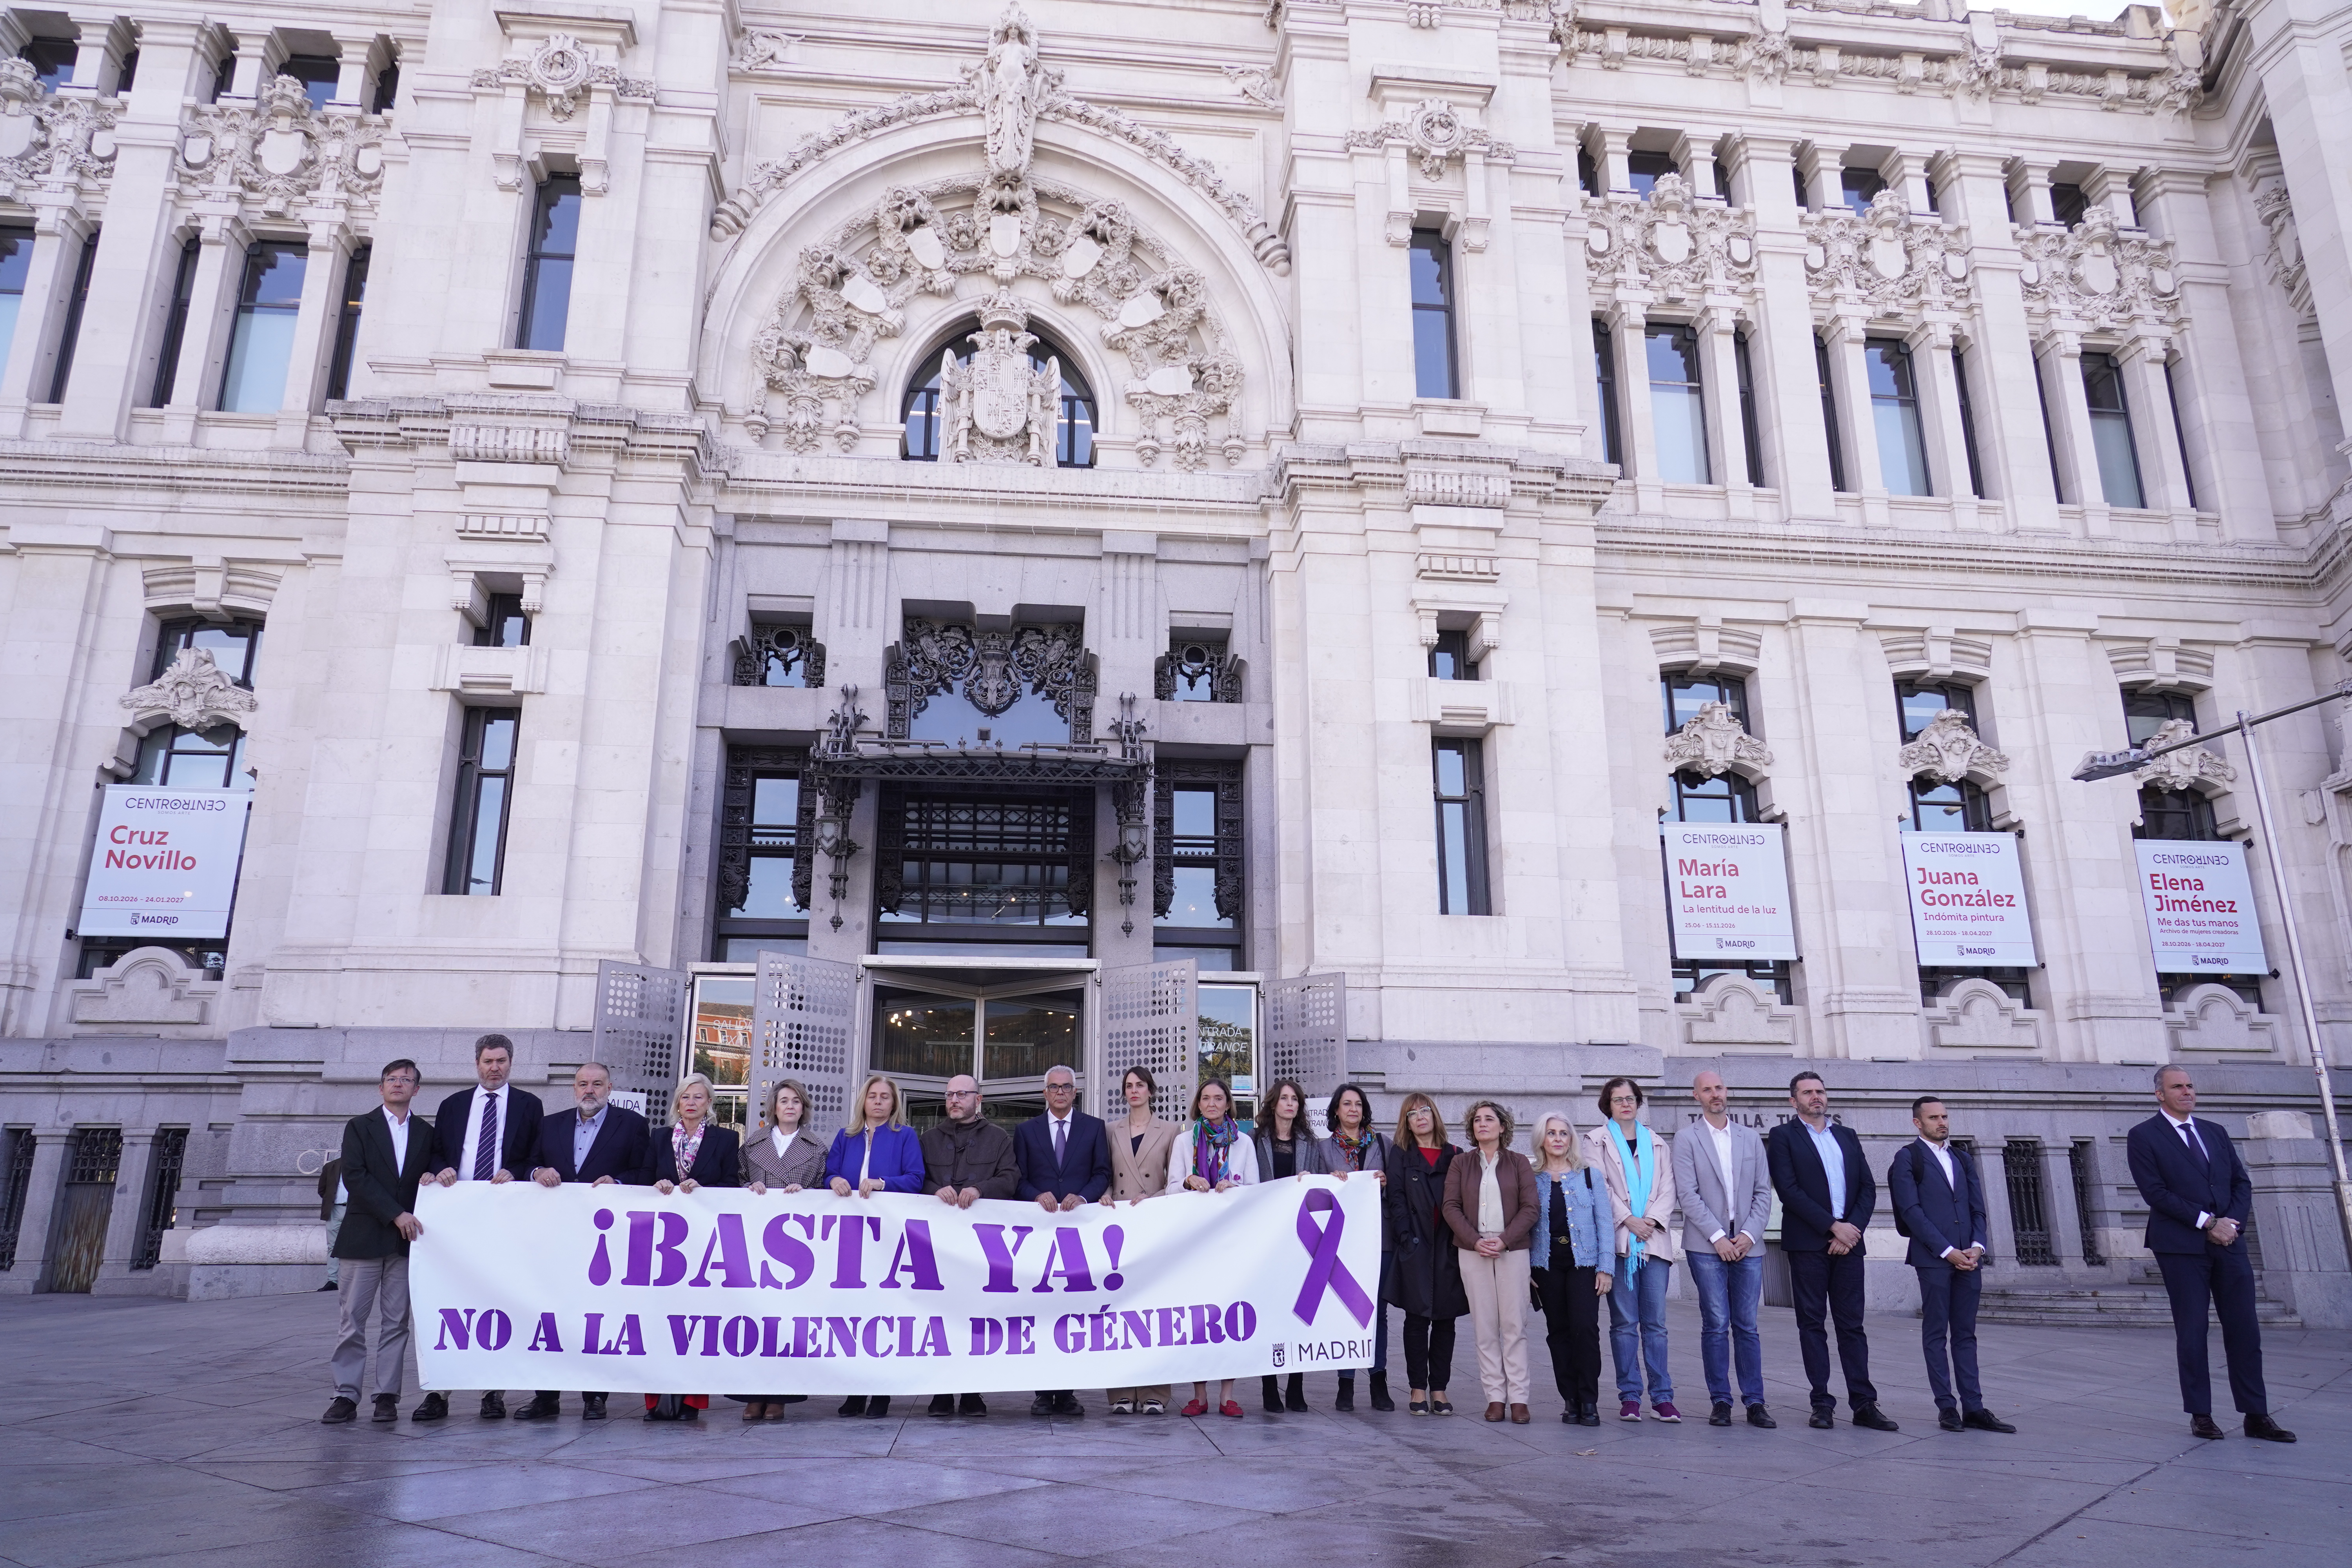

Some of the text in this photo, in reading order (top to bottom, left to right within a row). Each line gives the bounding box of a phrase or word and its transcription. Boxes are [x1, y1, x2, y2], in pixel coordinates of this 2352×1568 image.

[111, 826, 169, 845] Cruz
[105, 850, 196, 870] Novillo
[1679, 859, 1739, 876] María
[1917, 868, 1978, 885] Juana
[2150, 873, 2204, 891] Elena
[1681, 881, 1726, 898] Lara
[1921, 889, 2015, 907] González
[1697, 905, 1734, 913] lentitud
[1738, 905, 1749, 913] de
[2154, 895, 2237, 913] Jiménez
[142, 916, 178, 925] MADRID
[1971, 913, 2004, 922] pintura
[1198, 1027, 1243, 1037] NTRADA
[1198, 1042, 1248, 1052] TRANCE
[589, 1209, 1124, 1292] ¡BASTA YA!
[434, 1301, 1256, 1357] NO A LA VIOLENCIA DE GÉNERO
